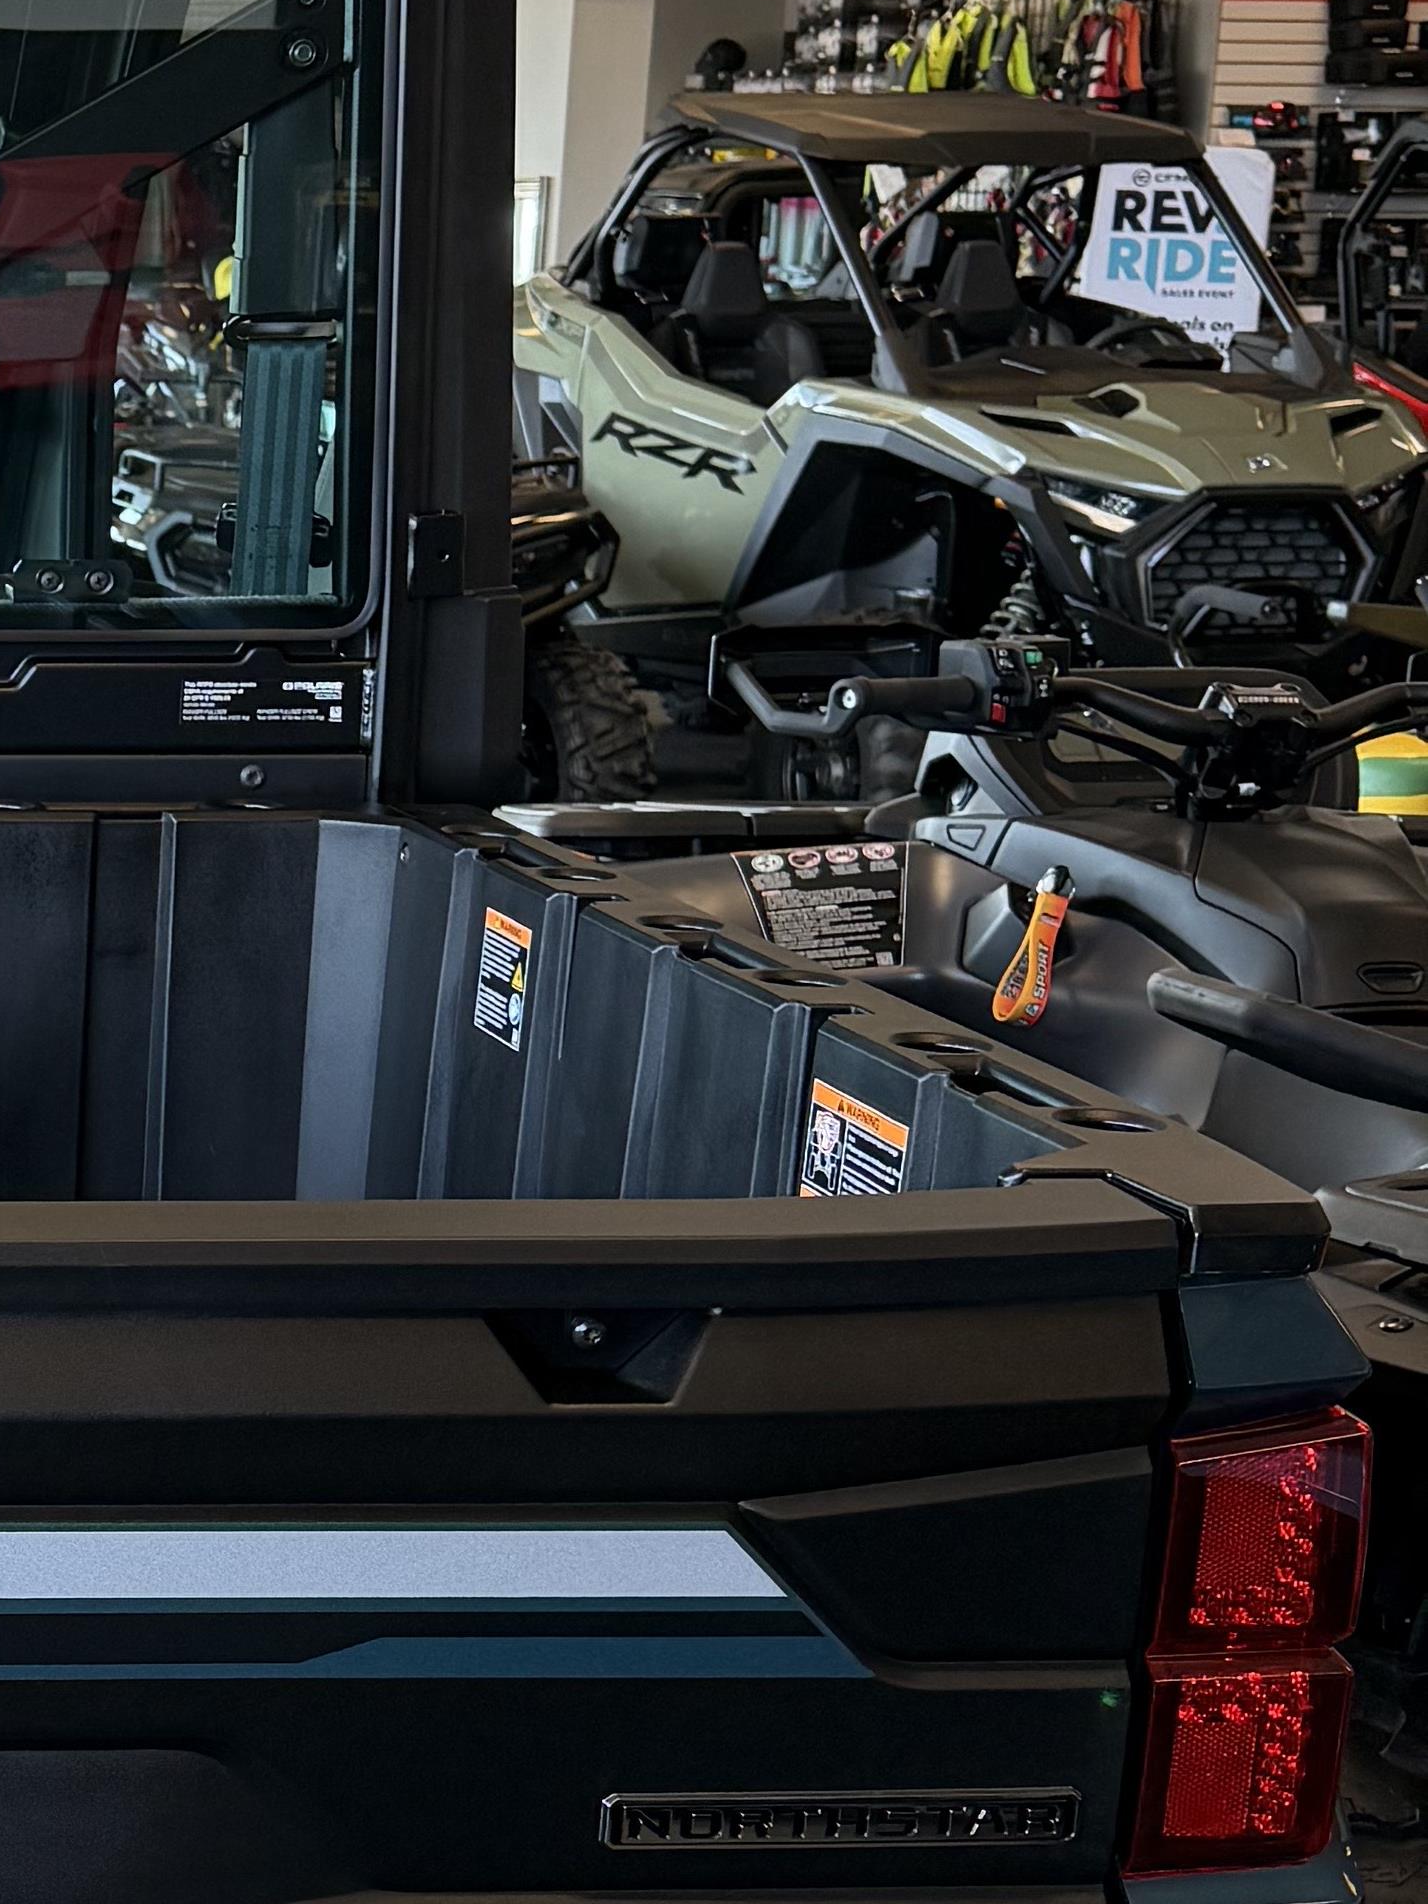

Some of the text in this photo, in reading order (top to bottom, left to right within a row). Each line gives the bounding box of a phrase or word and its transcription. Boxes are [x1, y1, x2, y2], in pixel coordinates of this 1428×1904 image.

[1110, 189, 1217, 234] REV
[1106, 237, 1237, 295] RIDE
[1197, 289, 1236, 299] EVENT
[1210, 320, 1235, 332] on
[590, 411, 758, 497] RZR
[1032, 938, 1051, 1000] SPORT
[623, 1803, 1061, 1840] NORTHSTAR
